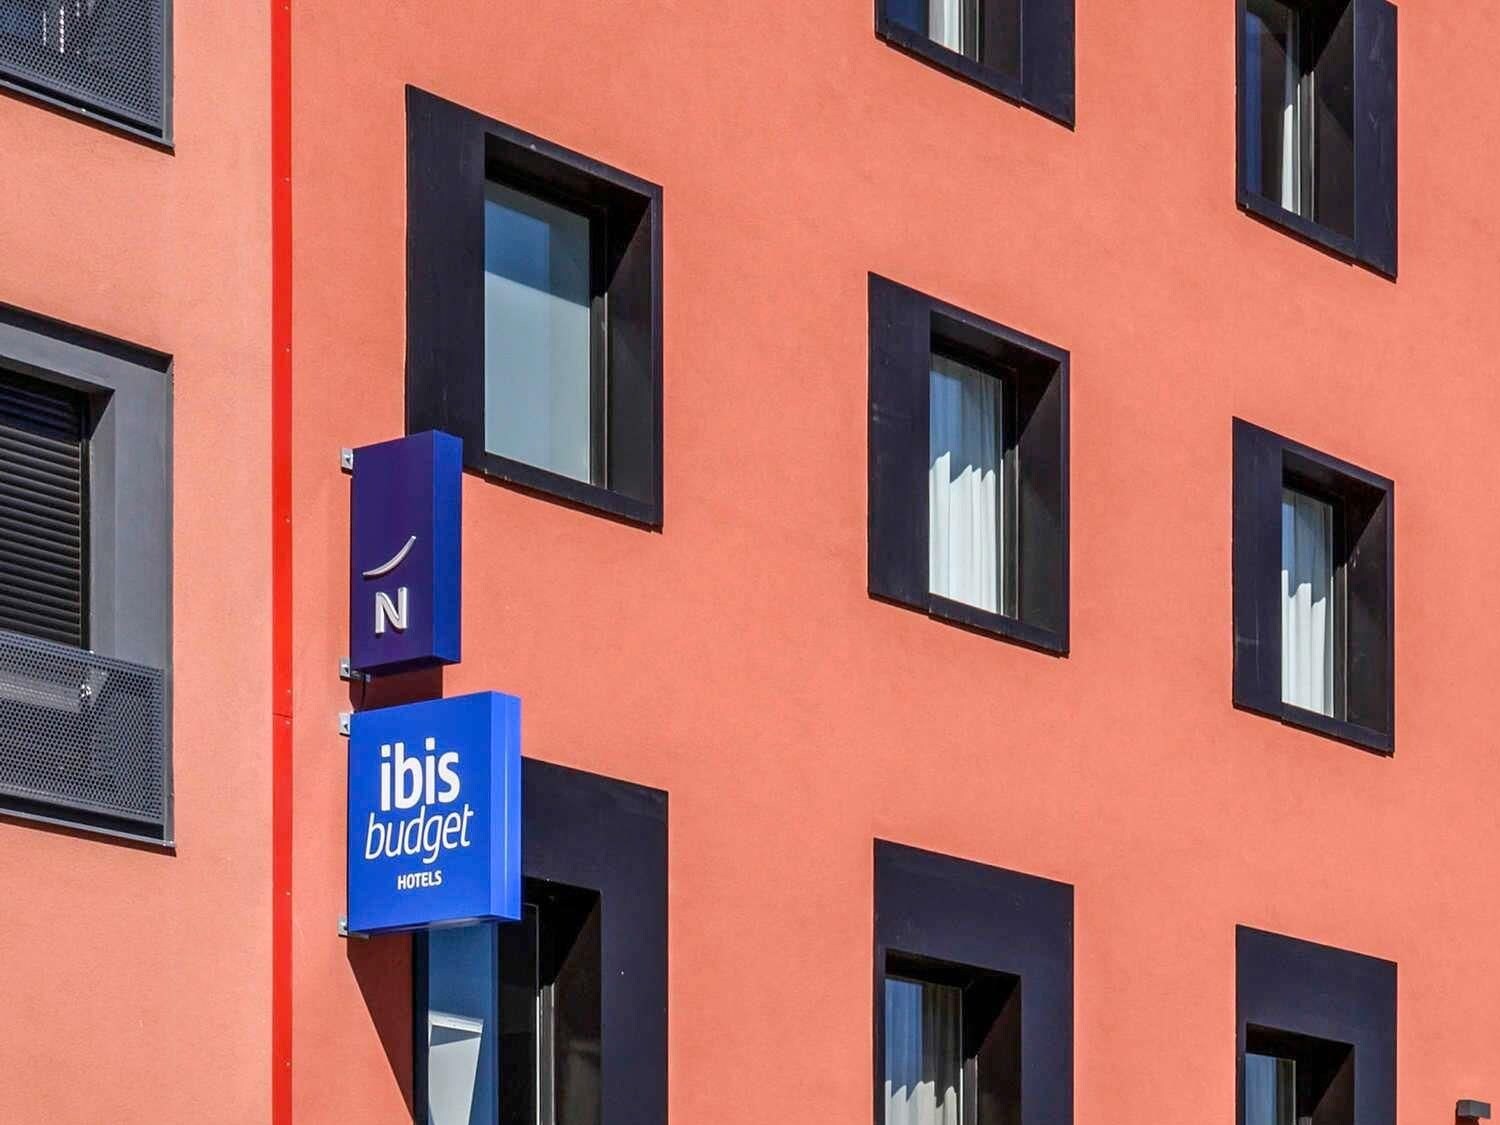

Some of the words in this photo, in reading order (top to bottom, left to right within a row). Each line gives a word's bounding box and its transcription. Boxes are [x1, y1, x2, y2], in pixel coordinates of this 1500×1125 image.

[375, 586, 408, 633] N
[381, 737, 460, 811] ibis
[365, 804, 475, 864] budget
[397, 870, 442, 890] HOTELS
